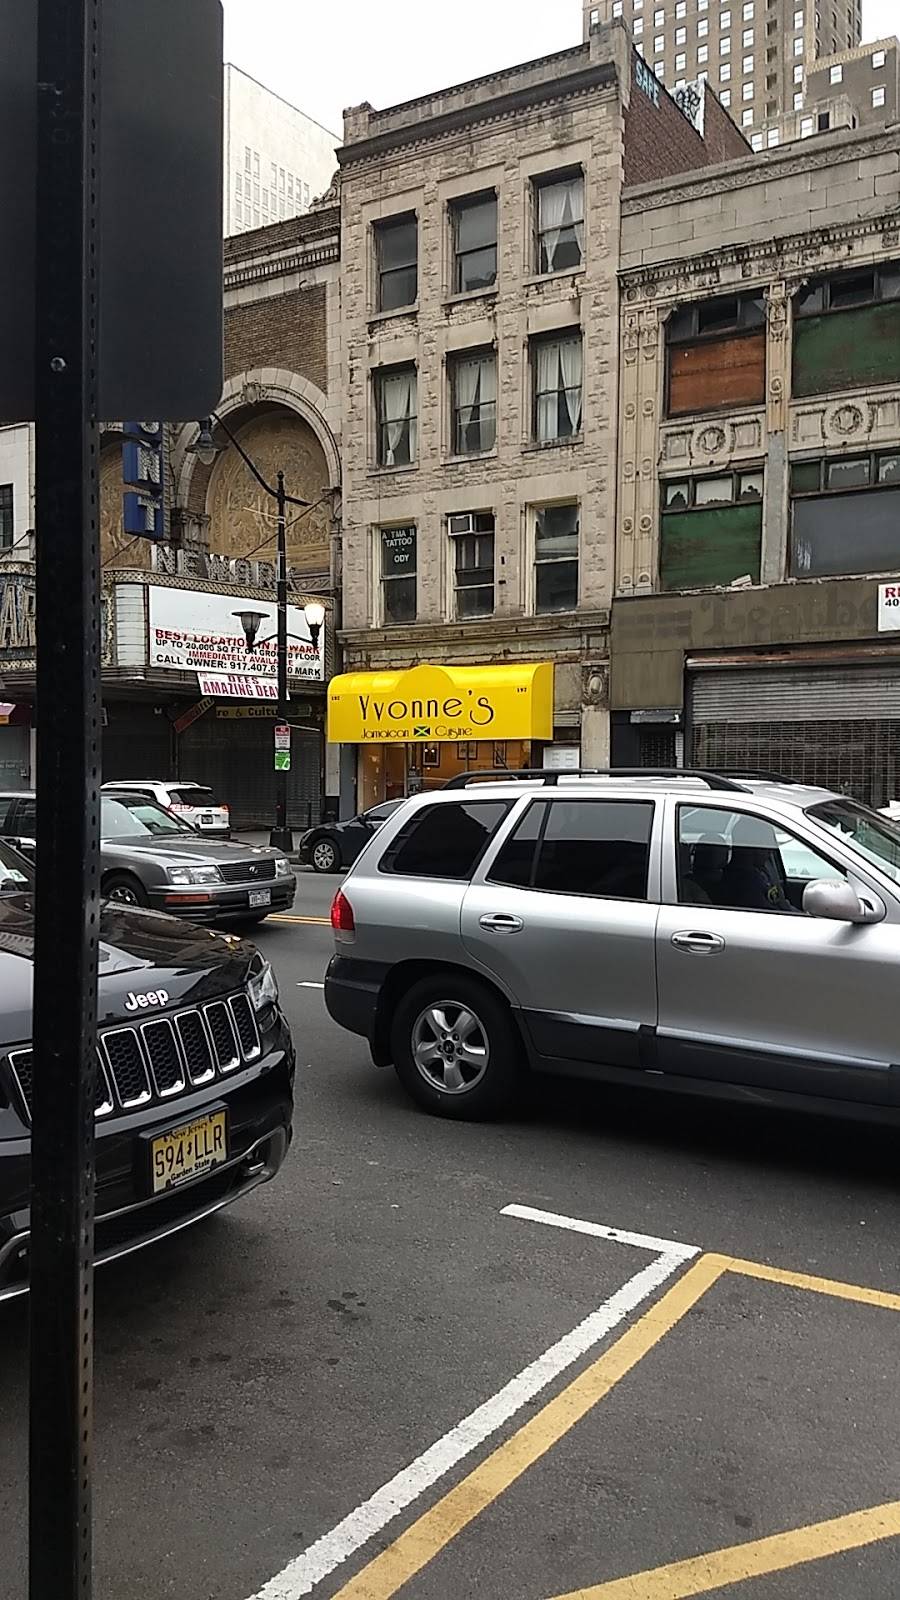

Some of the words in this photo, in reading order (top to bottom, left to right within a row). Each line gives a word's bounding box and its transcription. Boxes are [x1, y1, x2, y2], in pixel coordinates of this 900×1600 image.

[385, 537, 413, 547] TATTOO
[155, 629, 188, 642] BEST
[155, 638, 168, 647] UP
[171, 640, 183, 648] TO
[216, 645, 229, 653] SQ
[230, 646, 243, 654] FT.
[188, 650, 247, 662] IMMEDIATELY
[156, 654, 183, 665] CALL
[186, 657, 227, 669] OWNER:
[294, 667, 321, 676] MARK
[203, 681, 254, 697] AMAZING
[359, 690, 494, 725] Yvonne's
[361, 728, 409, 738] Jamaican
[125, 989, 169, 1011] Jeep
[170, 1167, 193, 1181] Garden
[194, 1158, 210, 1171] State
